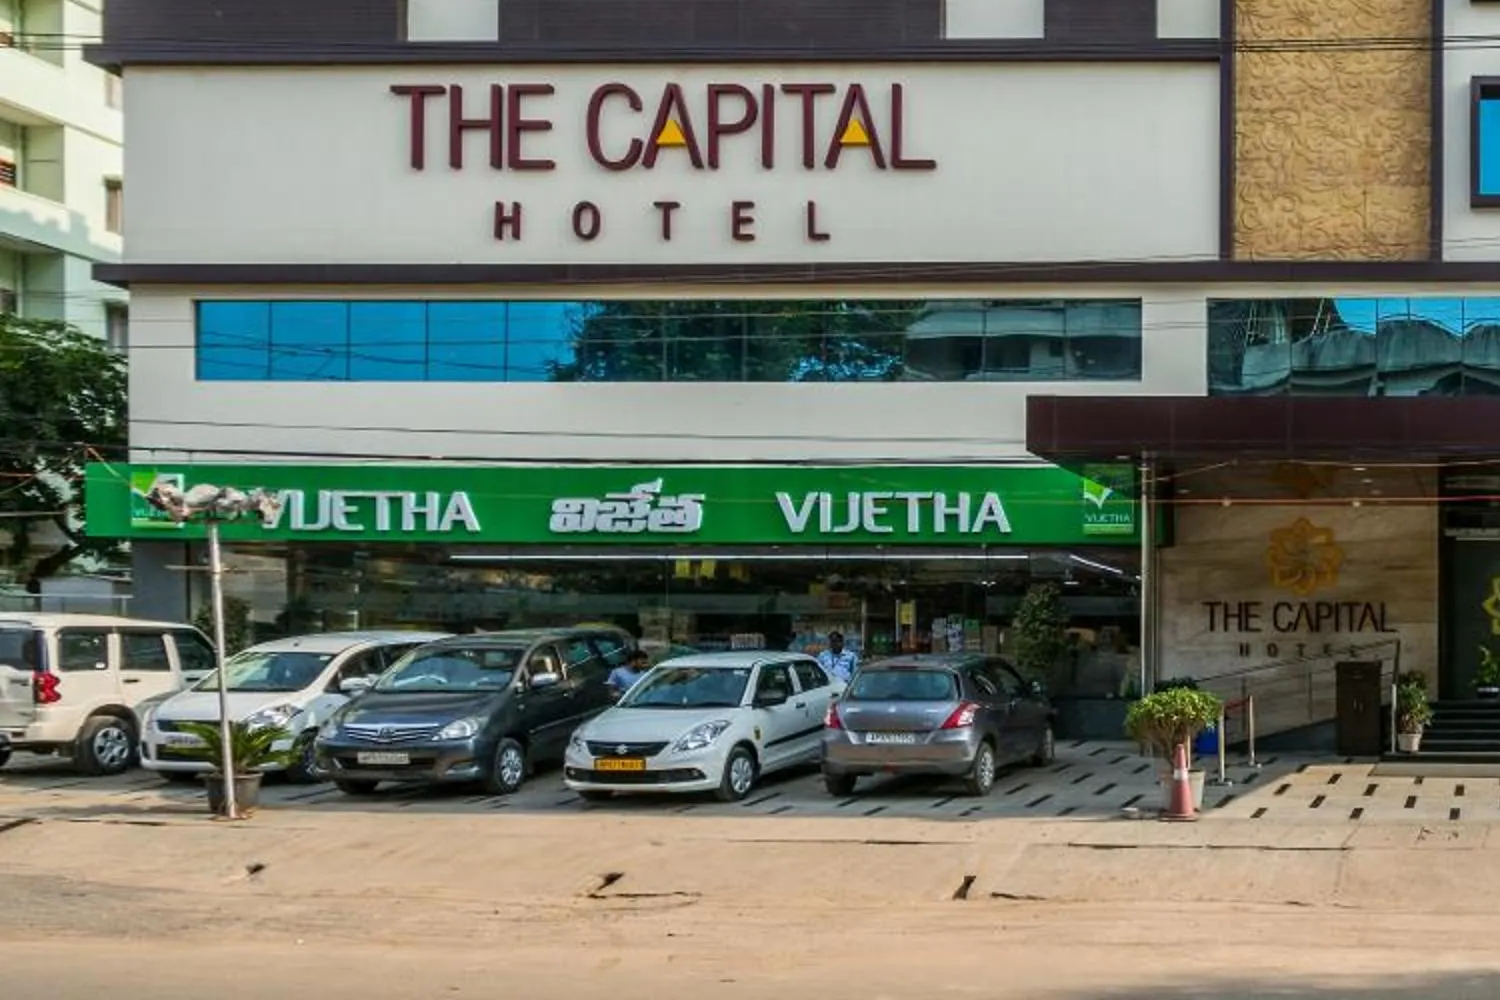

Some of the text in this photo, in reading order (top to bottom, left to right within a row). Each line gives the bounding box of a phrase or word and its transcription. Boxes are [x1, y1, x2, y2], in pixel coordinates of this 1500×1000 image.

[389, 82, 937, 171] THE CAPITAL
[494, 200, 832, 242] HOTEL
[550, 477, 706, 533] విజేత
[776, 491, 1012, 534] VIJETHA
[1084, 513, 1131, 522] VIJETHA
[1202, 601, 1399, 633] THE CAPITAL
[1239, 643, 1358, 658] HOTEL
